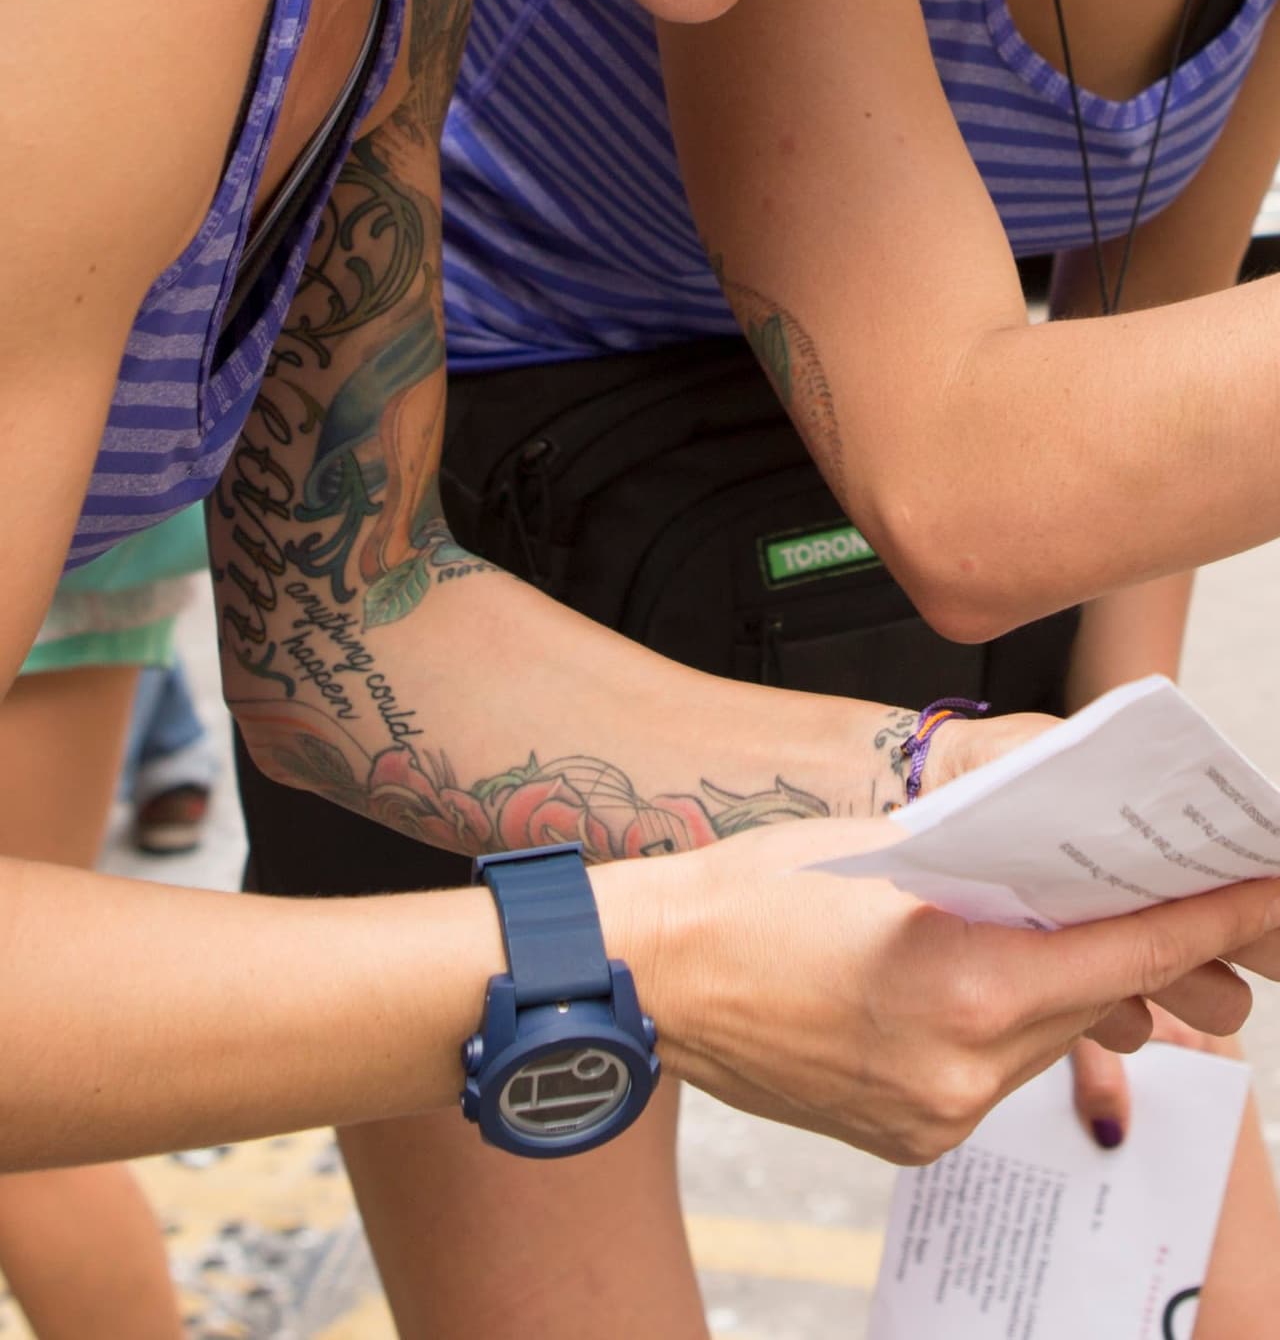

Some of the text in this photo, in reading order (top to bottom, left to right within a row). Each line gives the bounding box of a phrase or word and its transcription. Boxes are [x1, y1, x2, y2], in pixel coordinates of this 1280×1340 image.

[779, 531, 869, 571] TORON
[281, 631, 361, 720] happen
[284, 581, 424, 746] anything could
